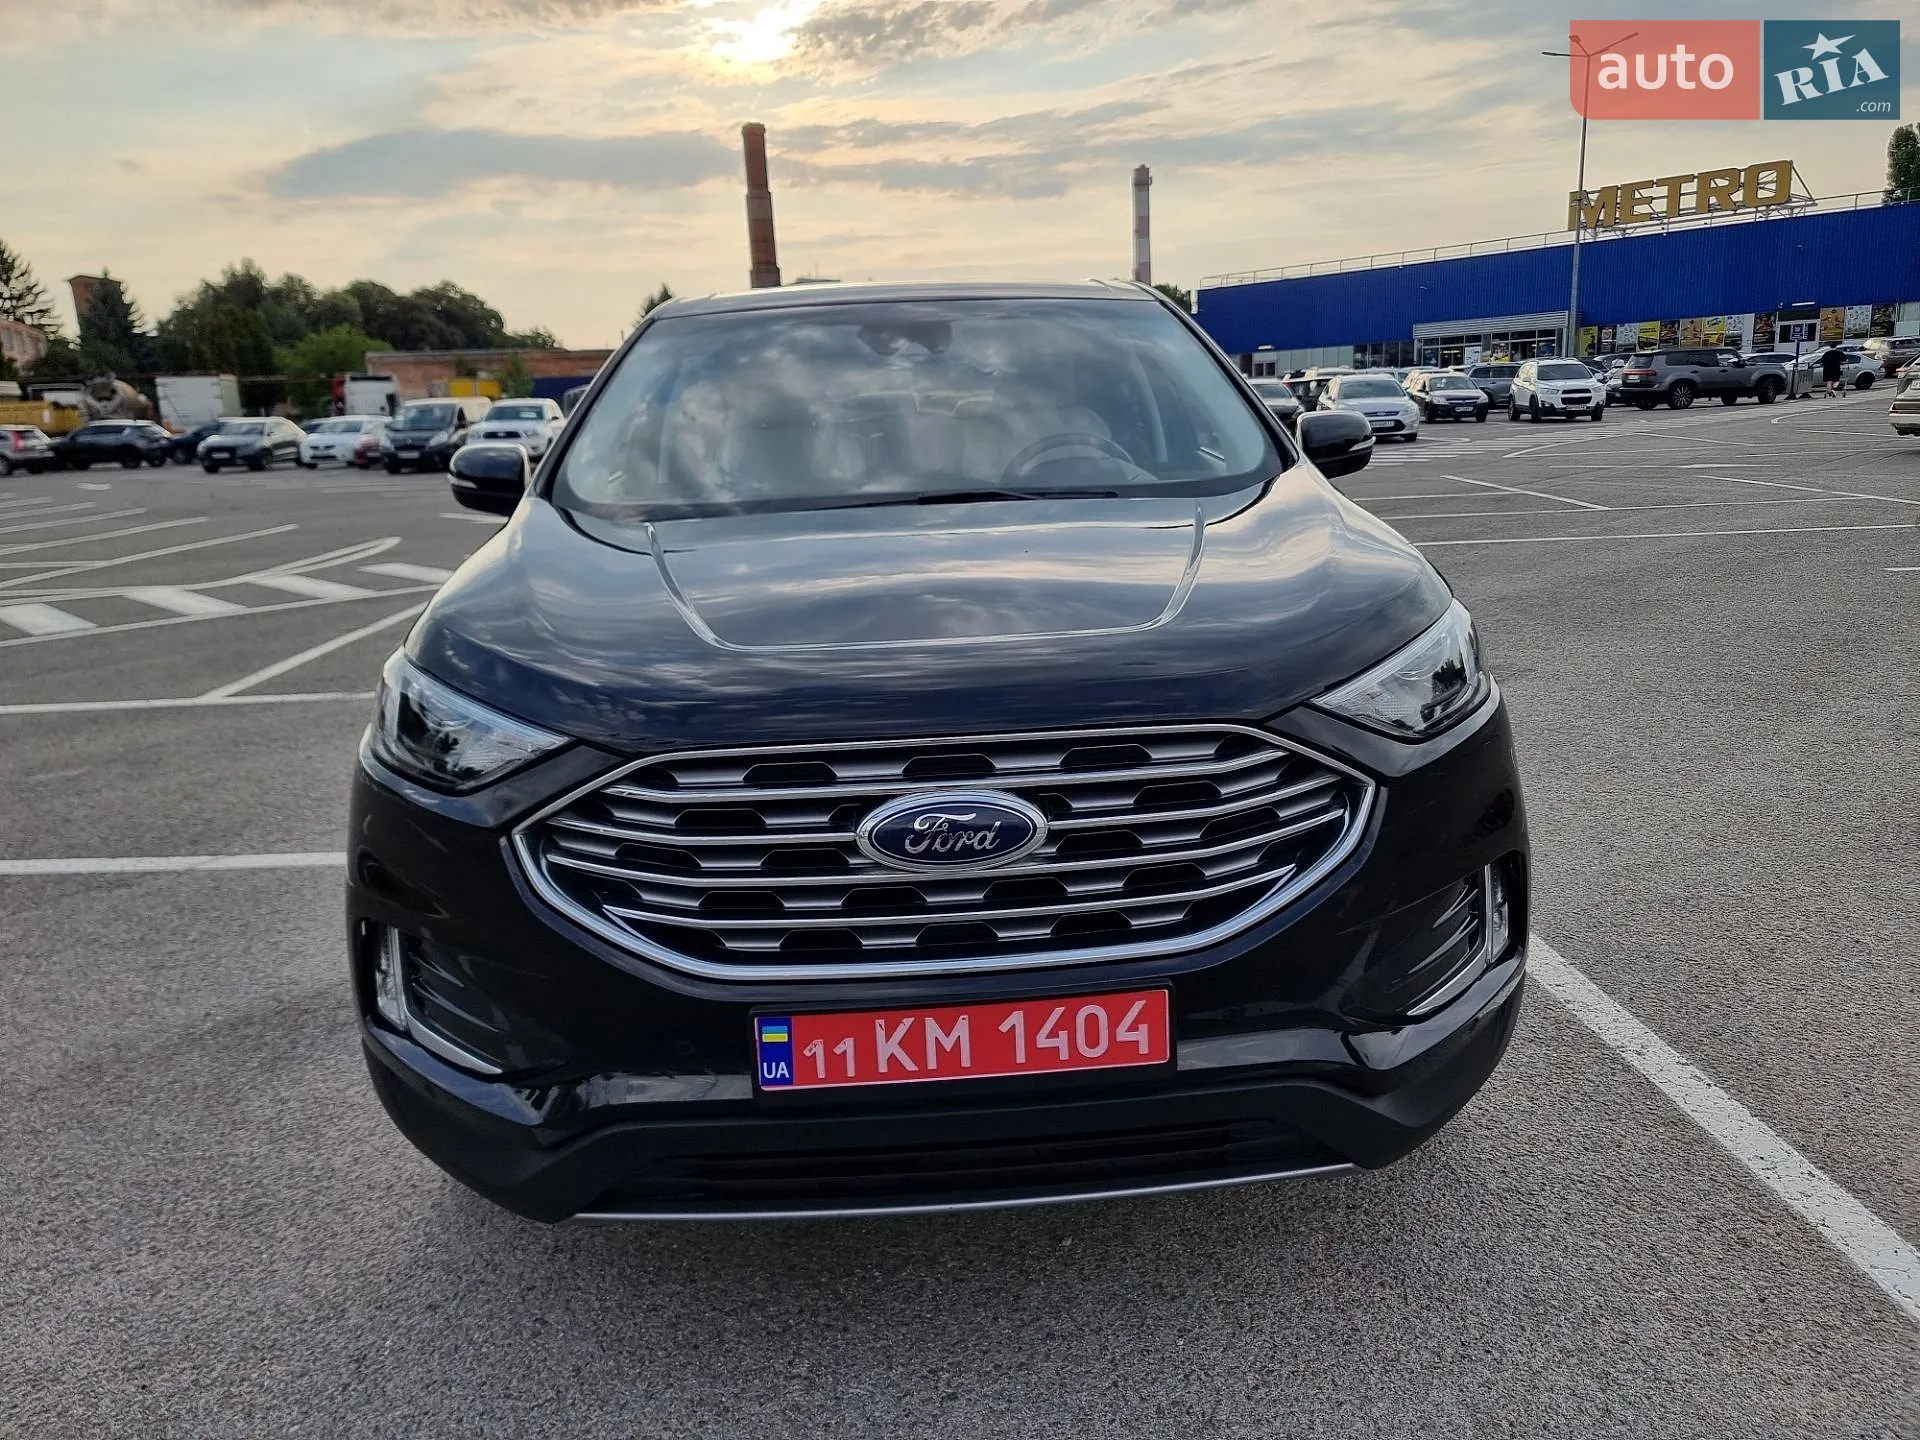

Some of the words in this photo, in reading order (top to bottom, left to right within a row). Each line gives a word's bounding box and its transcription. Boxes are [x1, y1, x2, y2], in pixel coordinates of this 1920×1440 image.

[1568, 160, 1792, 231] METRO
[904, 812, 1002, 854] Ford
[803, 1037, 856, 1079] 11
[875, 1014, 972, 1073] KM
[998, 1000, 1149, 1064] 1404
[763, 1061, 789, 1080] UA
